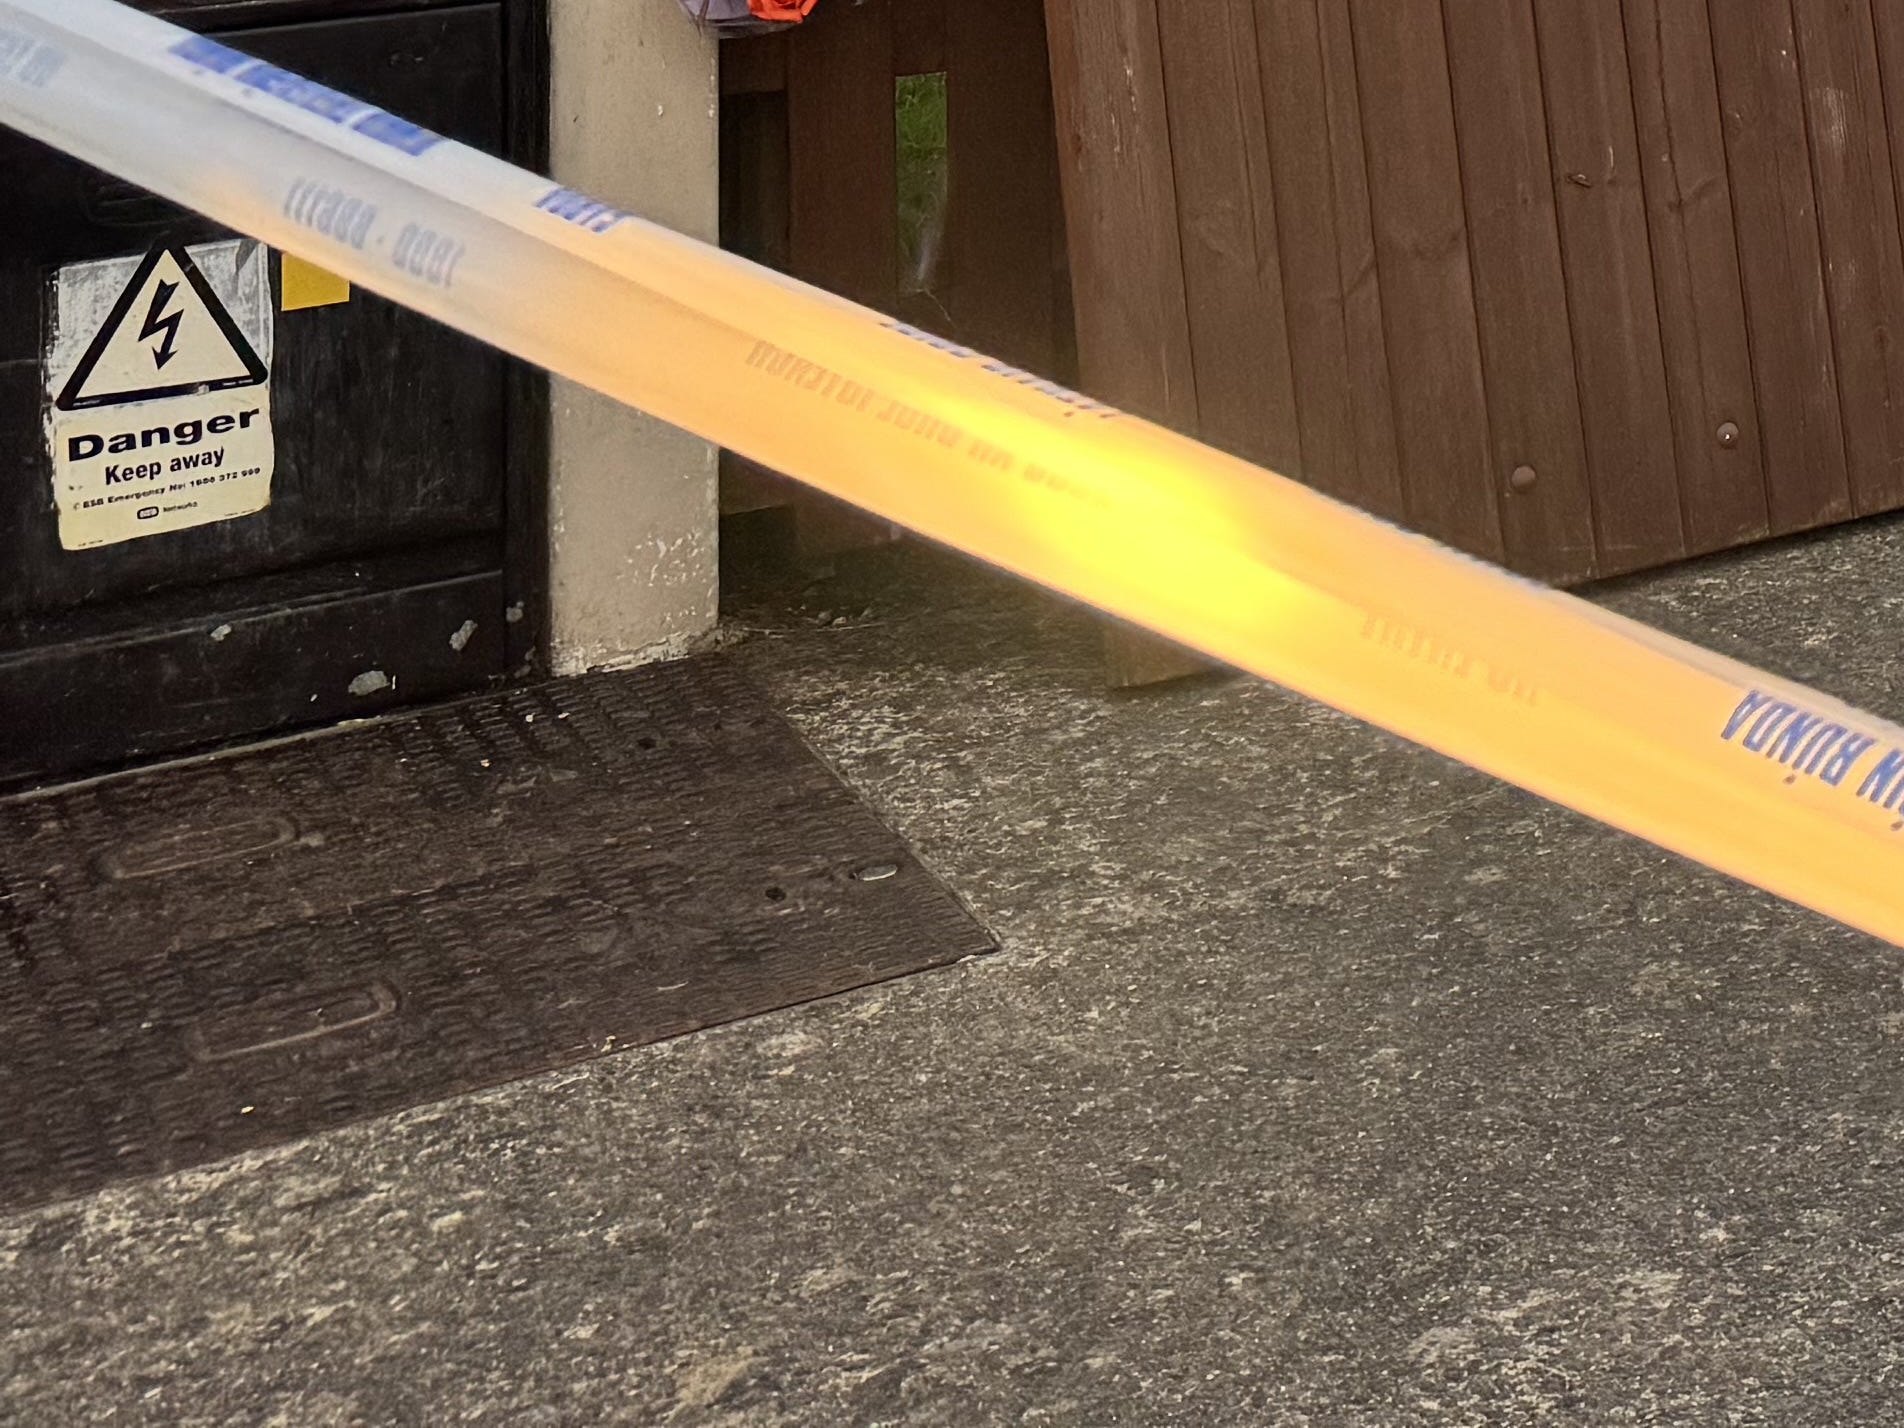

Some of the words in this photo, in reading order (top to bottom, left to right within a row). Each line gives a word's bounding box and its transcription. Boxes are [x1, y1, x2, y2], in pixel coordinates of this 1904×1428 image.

[68, 409, 260, 461] Danger
[105, 462, 162, 485] Keep
[169, 446, 225, 473] away
[1720, 689, 1876, 787] RÚNDA
